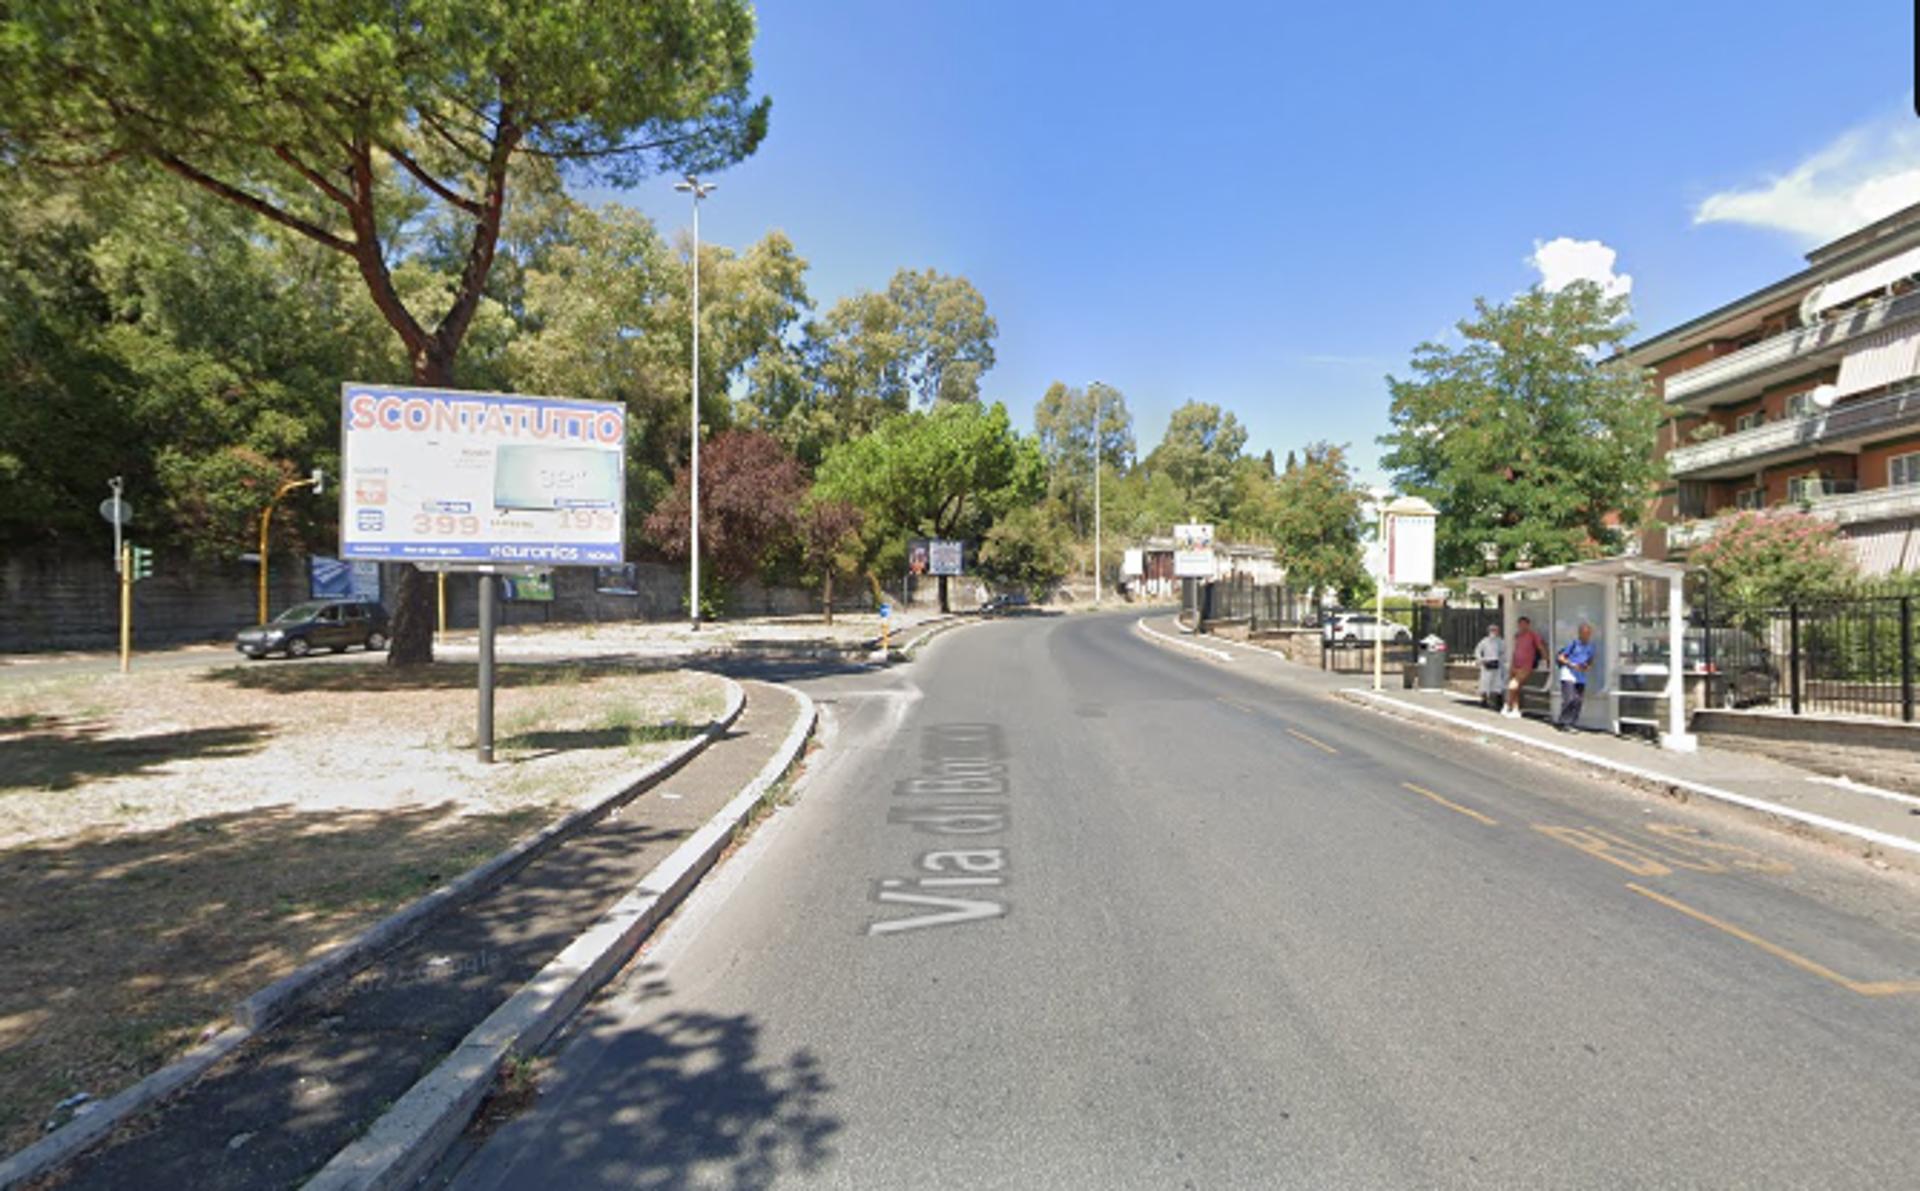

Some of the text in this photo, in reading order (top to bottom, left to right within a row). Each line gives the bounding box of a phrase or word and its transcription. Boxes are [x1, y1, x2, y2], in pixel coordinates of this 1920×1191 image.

[352, 394, 622, 443] SCONTATUTTO
[413, 513, 479, 535] 399
[500, 545, 579, 561] euronics
